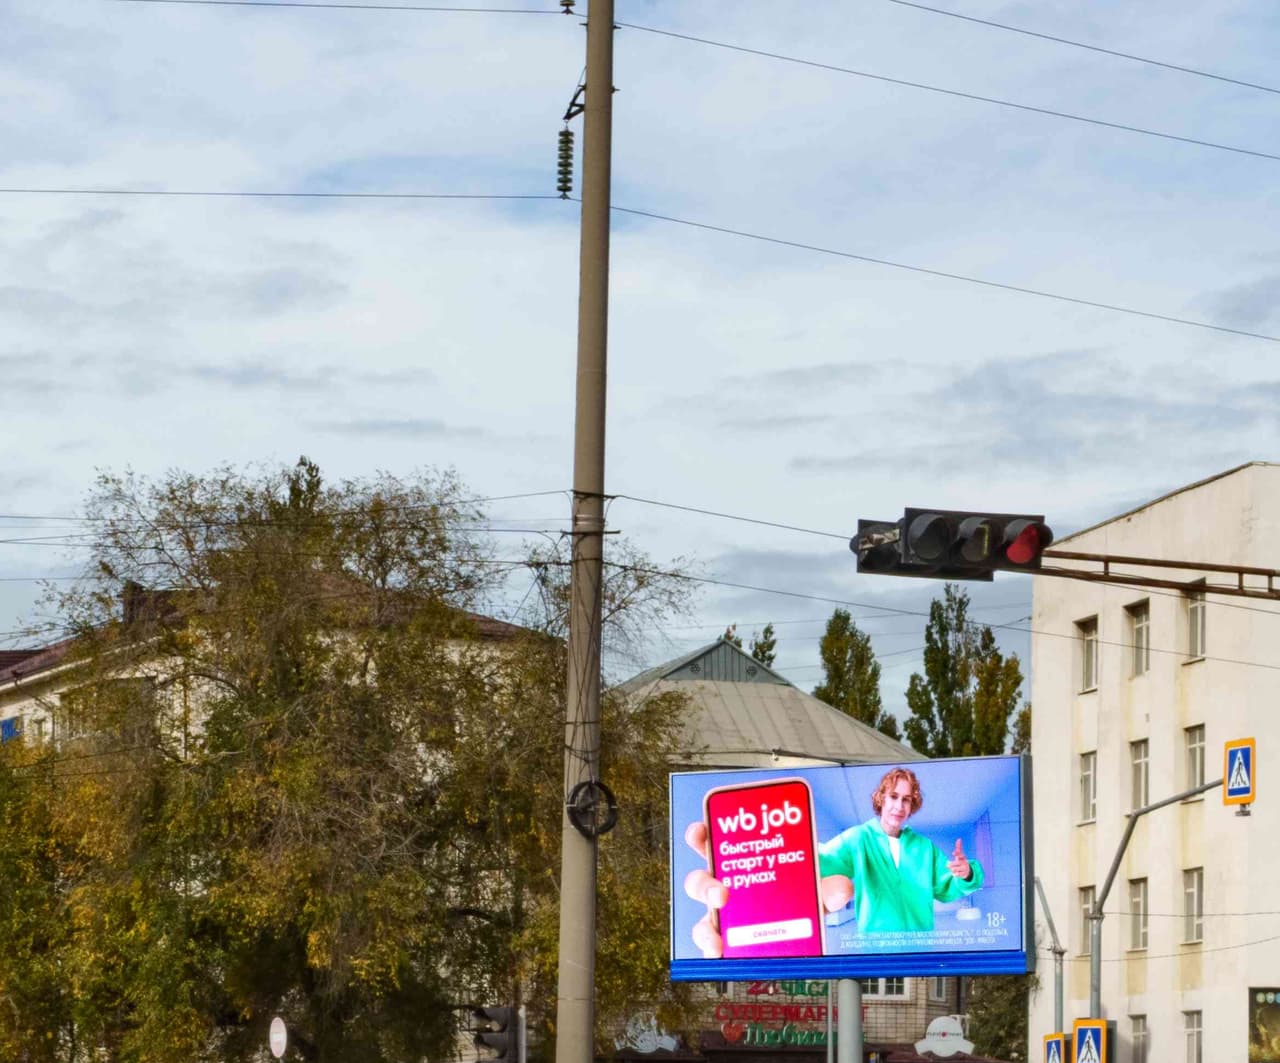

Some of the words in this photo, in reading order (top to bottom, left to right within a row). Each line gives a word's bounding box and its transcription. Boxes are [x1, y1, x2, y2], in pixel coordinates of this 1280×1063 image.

[718, 807, 757, 834] wb
[760, 800, 802, 835] job
[720, 834, 785, 856] быстрый
[721, 856, 763, 872] старт
[766, 854, 776, 868] у
[778, 850, 805, 864] вас
[723, 876, 732, 887] в
[733, 870, 777, 890] руках
[986, 912, 1007, 927] 18+
